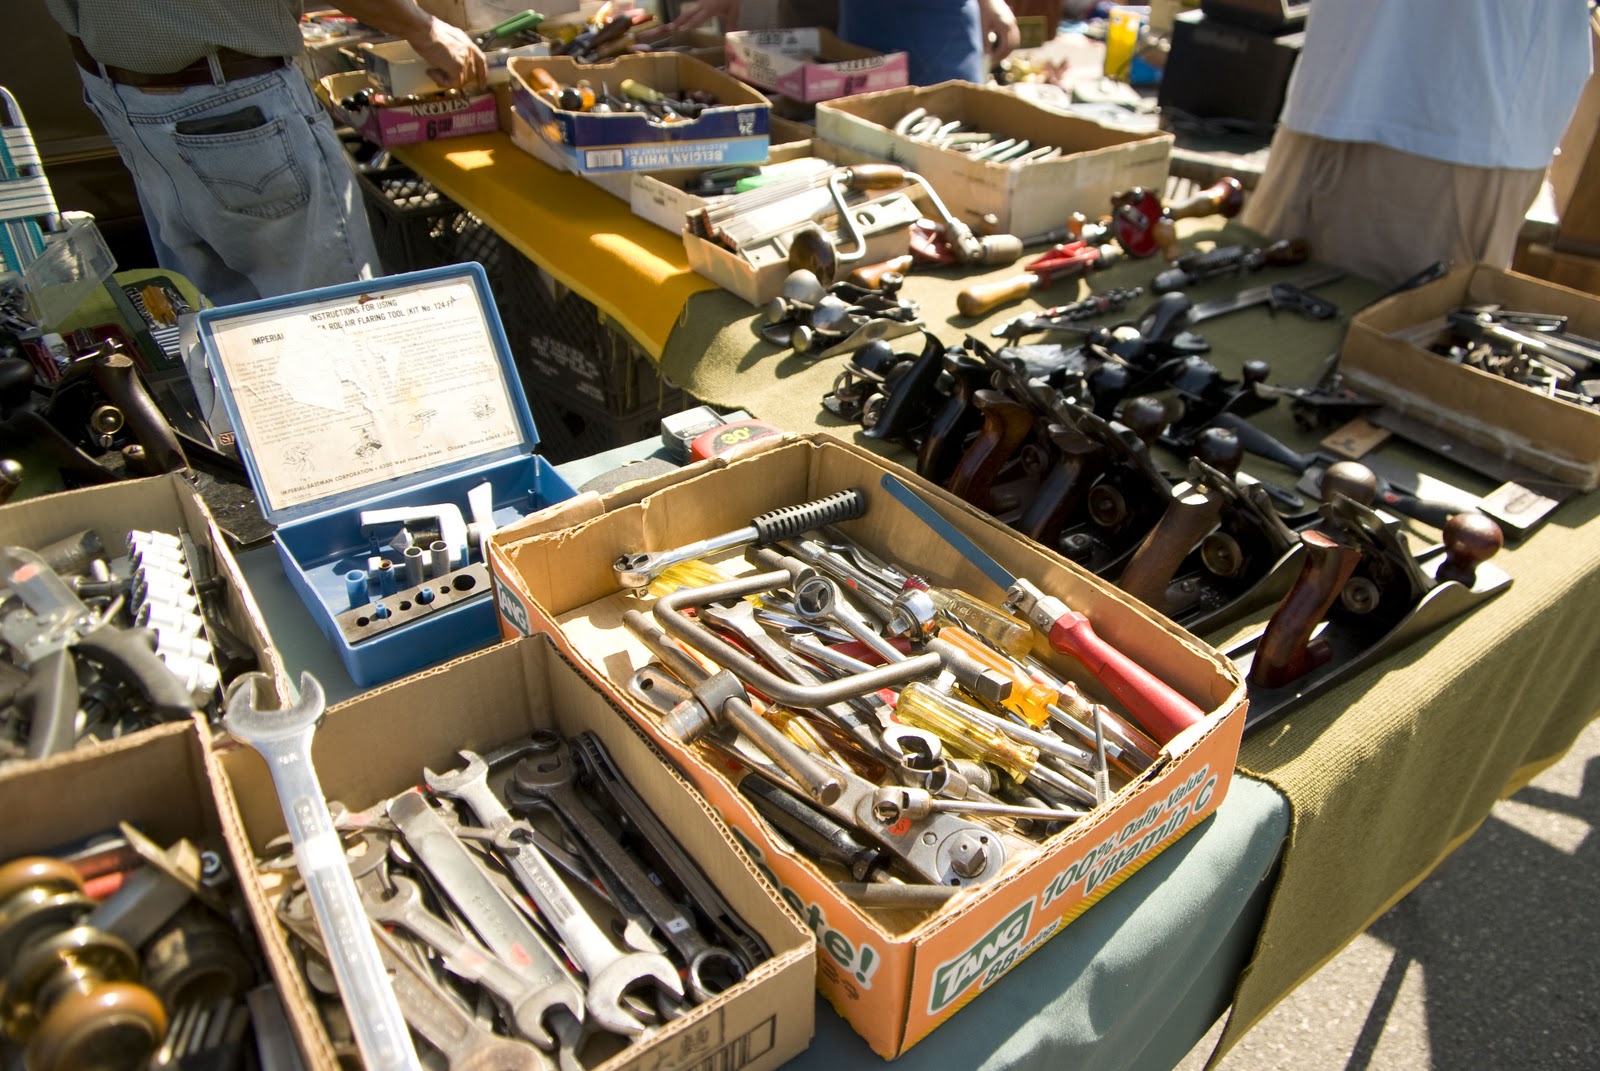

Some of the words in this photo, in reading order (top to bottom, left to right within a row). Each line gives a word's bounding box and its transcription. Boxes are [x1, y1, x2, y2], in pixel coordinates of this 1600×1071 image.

[410, 98, 470, 116] NOODLES
[427, 120, 437, 140] 6
[631, 152, 670, 166] WHITE
[671, 149, 722, 163] BELGIAN
[309, 306, 360, 322] INSTRUCTIONS
[361, 304, 375, 313] FOR
[377, 299, 398, 309] USING
[358, 313, 386, 325] FLARING
[387, 309, 405, 319] TOOL
[280, 478, 334, 496] IMPERIAL-EASTMAN
[334, 467, 374, 482] CORPORATION
[494, 575, 528, 630] TANG
[1043, 834, 1116, 907] 100%
[1118, 804, 1164, 843] Daily
[1167, 767, 1207, 810] Value
[1086, 805, 1189, 894] Vitamin
[1195, 778, 1216, 811] C
[940, 914, 1025, 1004] TANG
[982, 947, 1018, 985] 88
[1016, 920, 1058, 960] servings
